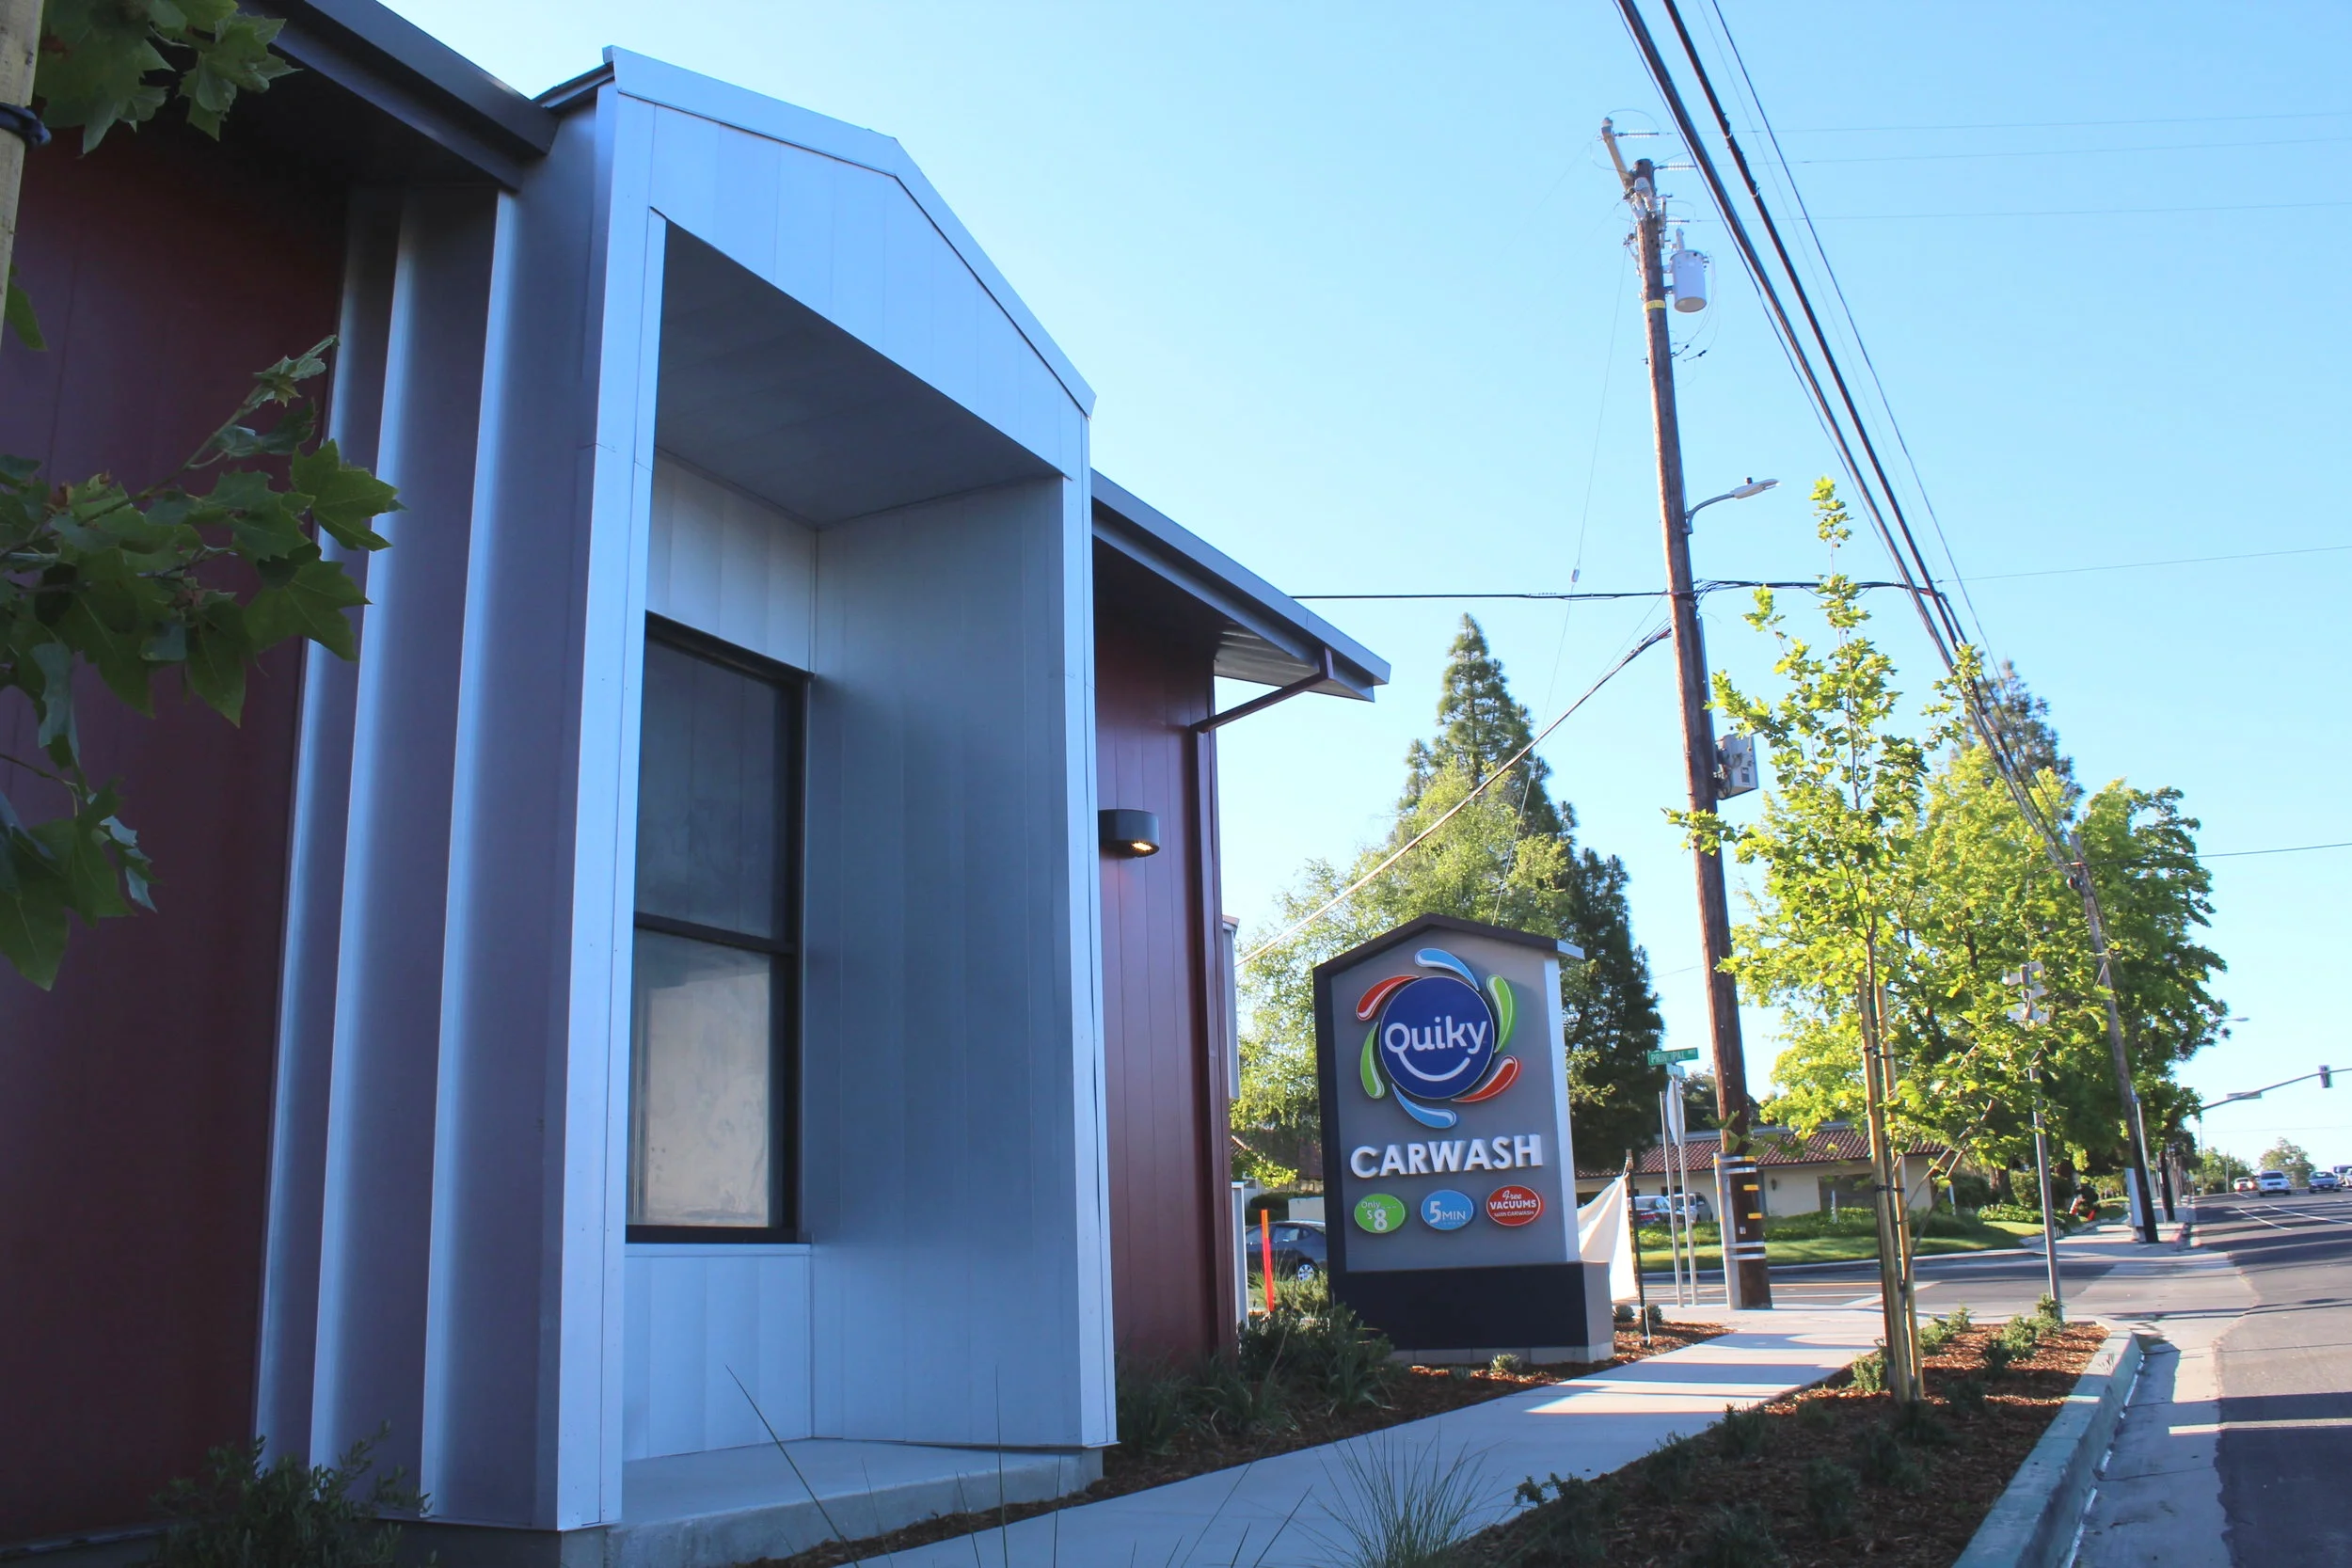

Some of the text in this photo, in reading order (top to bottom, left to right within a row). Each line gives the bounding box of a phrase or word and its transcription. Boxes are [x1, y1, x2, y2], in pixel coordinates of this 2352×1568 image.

[1384, 1015, 1487, 1081] Quiky
[1350, 1133, 1544, 1179] CARWASH
[1502, 1189, 1522, 1200] Free
[1360, 1200, 1380, 1210] Only
[1489, 1199, 1537, 1211] VACUUMS
